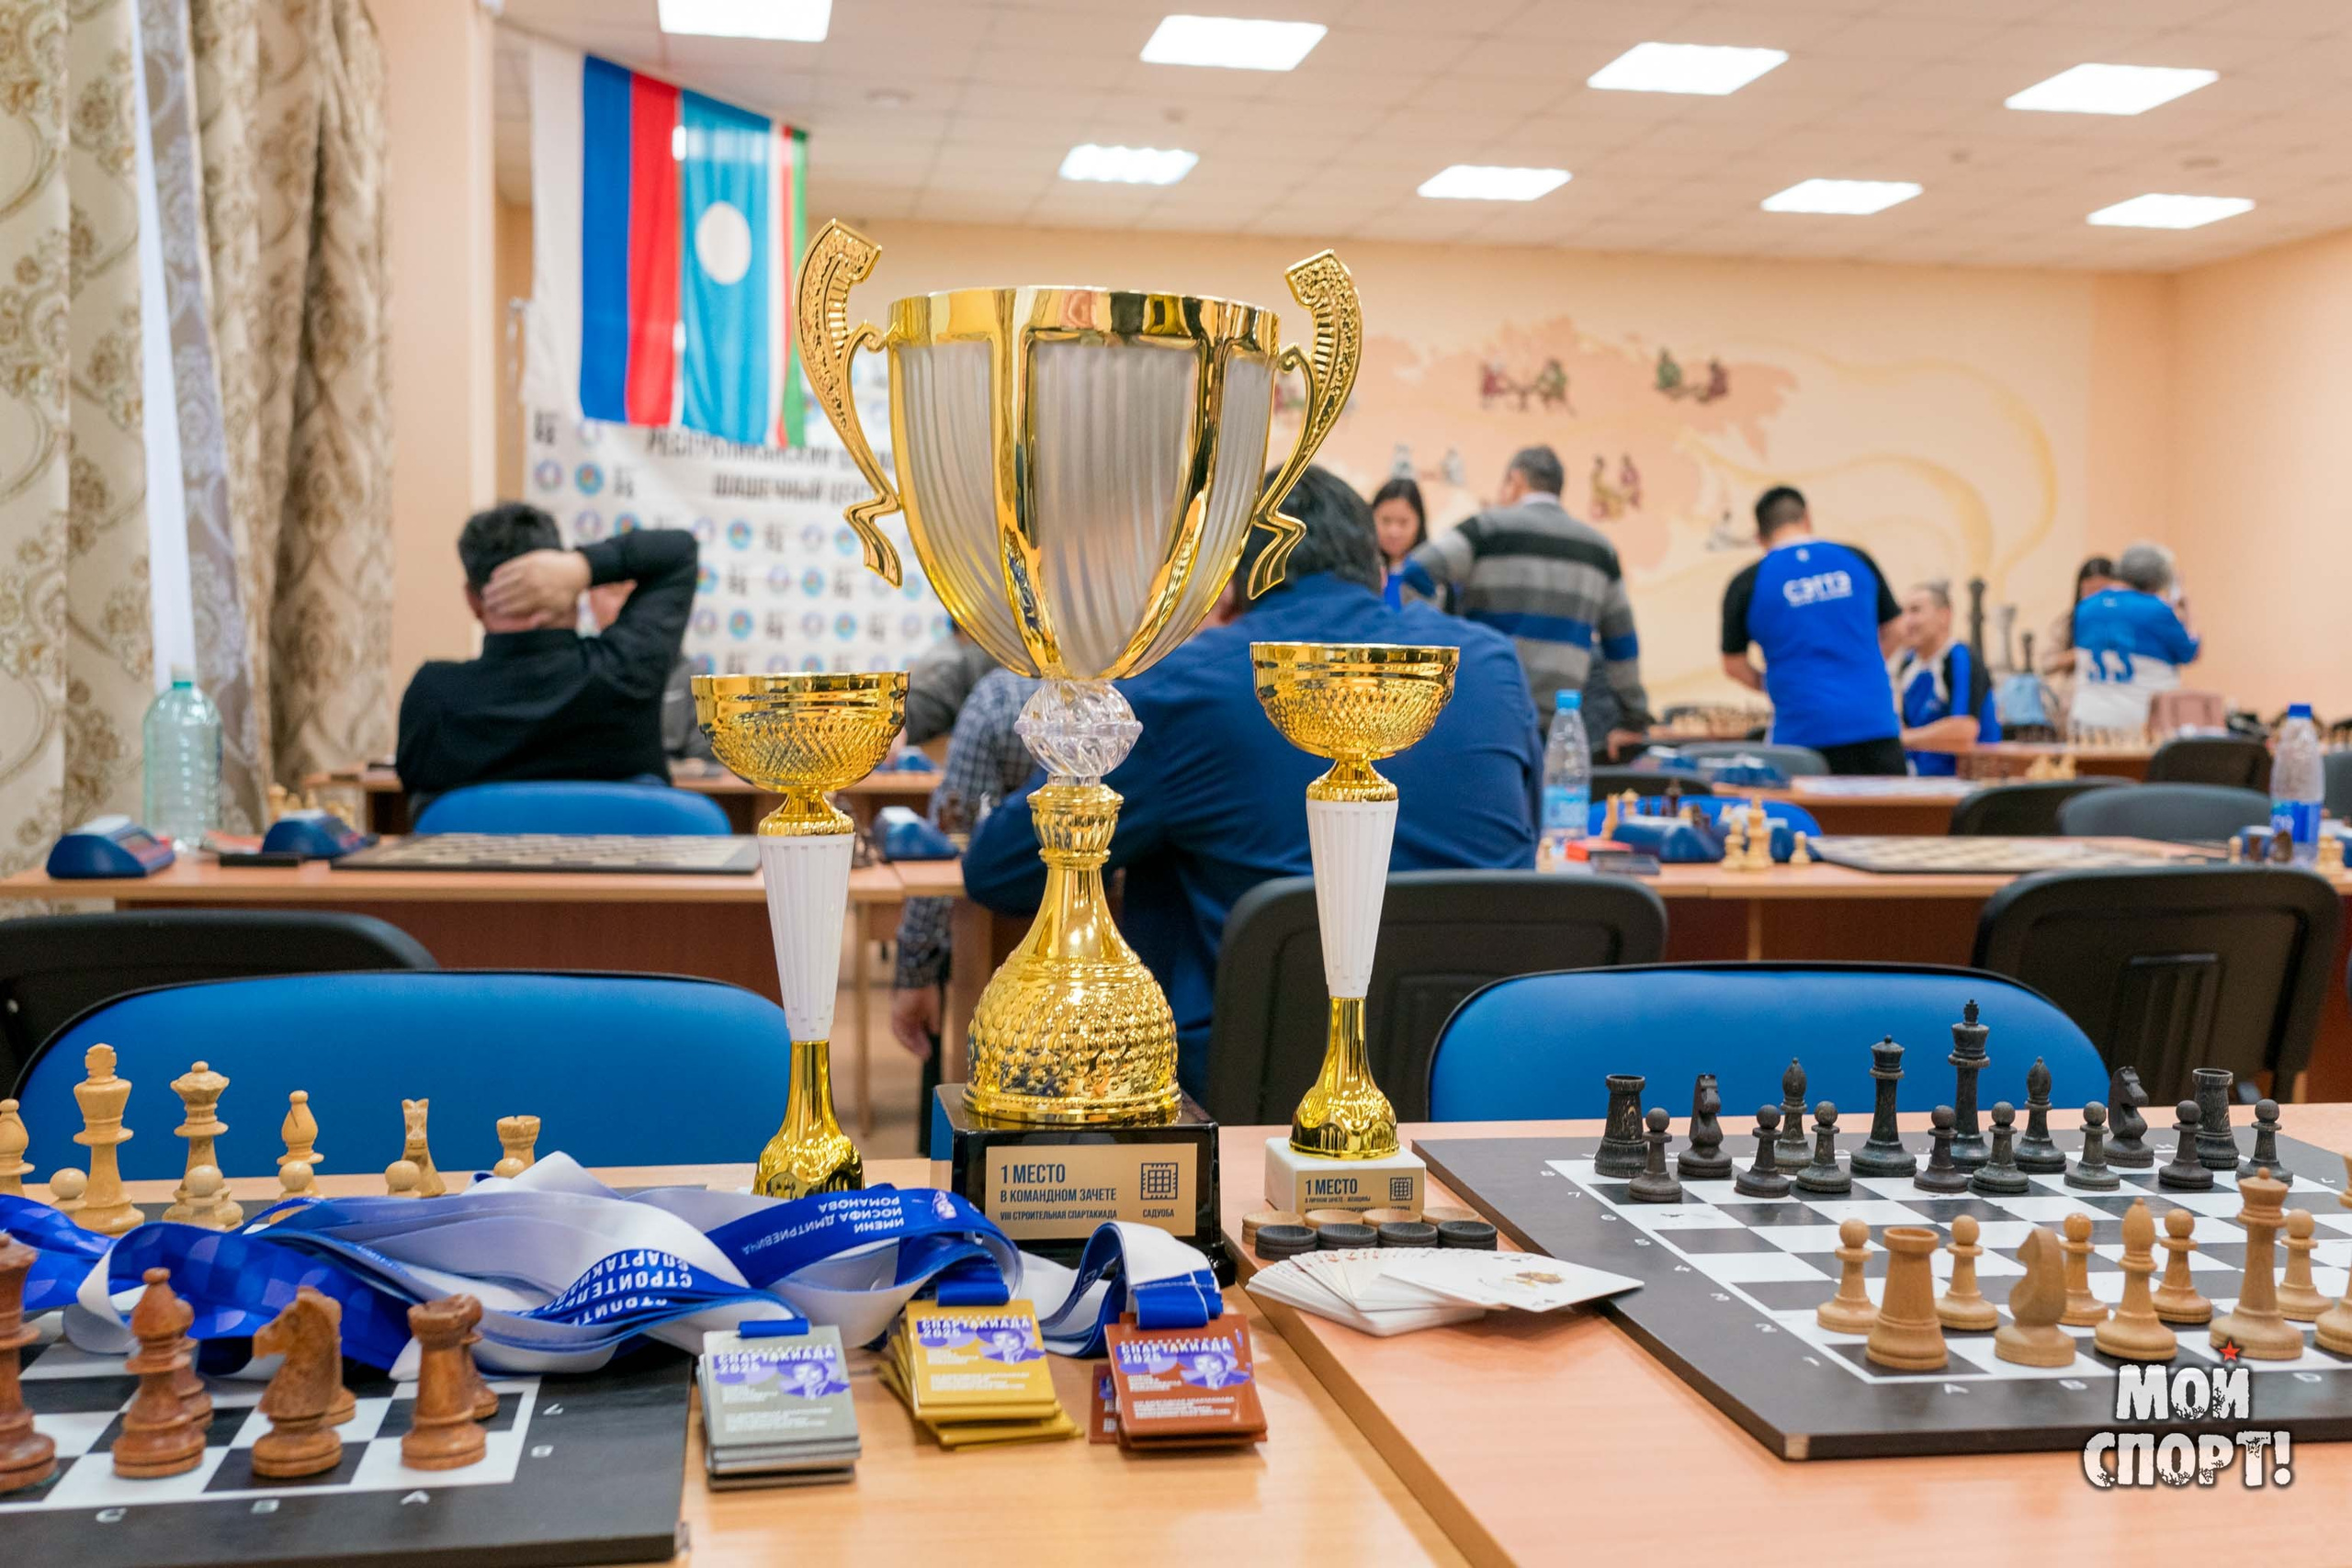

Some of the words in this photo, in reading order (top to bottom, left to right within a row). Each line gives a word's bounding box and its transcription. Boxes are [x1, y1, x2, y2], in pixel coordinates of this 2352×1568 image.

[1001, 1165, 1008, 1183] 1
[1012, 1163, 1066, 1183] МЕСТО
[1305, 1179, 1311, 1195] 1
[1315, 1178, 1358, 1195] МЕСТО
[1000, 1190, 1007, 1202] В
[1010, 1188, 1077, 1203] КОМАНДНОМ
[1080, 1188, 1116, 1201] ЗАЧЕТЕ
[818, 1196, 900, 1214] РОМАНОВА
[839, 1207, 903, 1223] ИОСИФА
[1012, 1210, 1066, 1221] СТРОИТЕЛЬНАЯ
[1068, 1209, 1117, 1220] СПАРТАКИАДА
[853, 1217, 905, 1234] ИМЕНИ
[741, 1213, 835, 1256] ДМИТРИЕВИЧА
